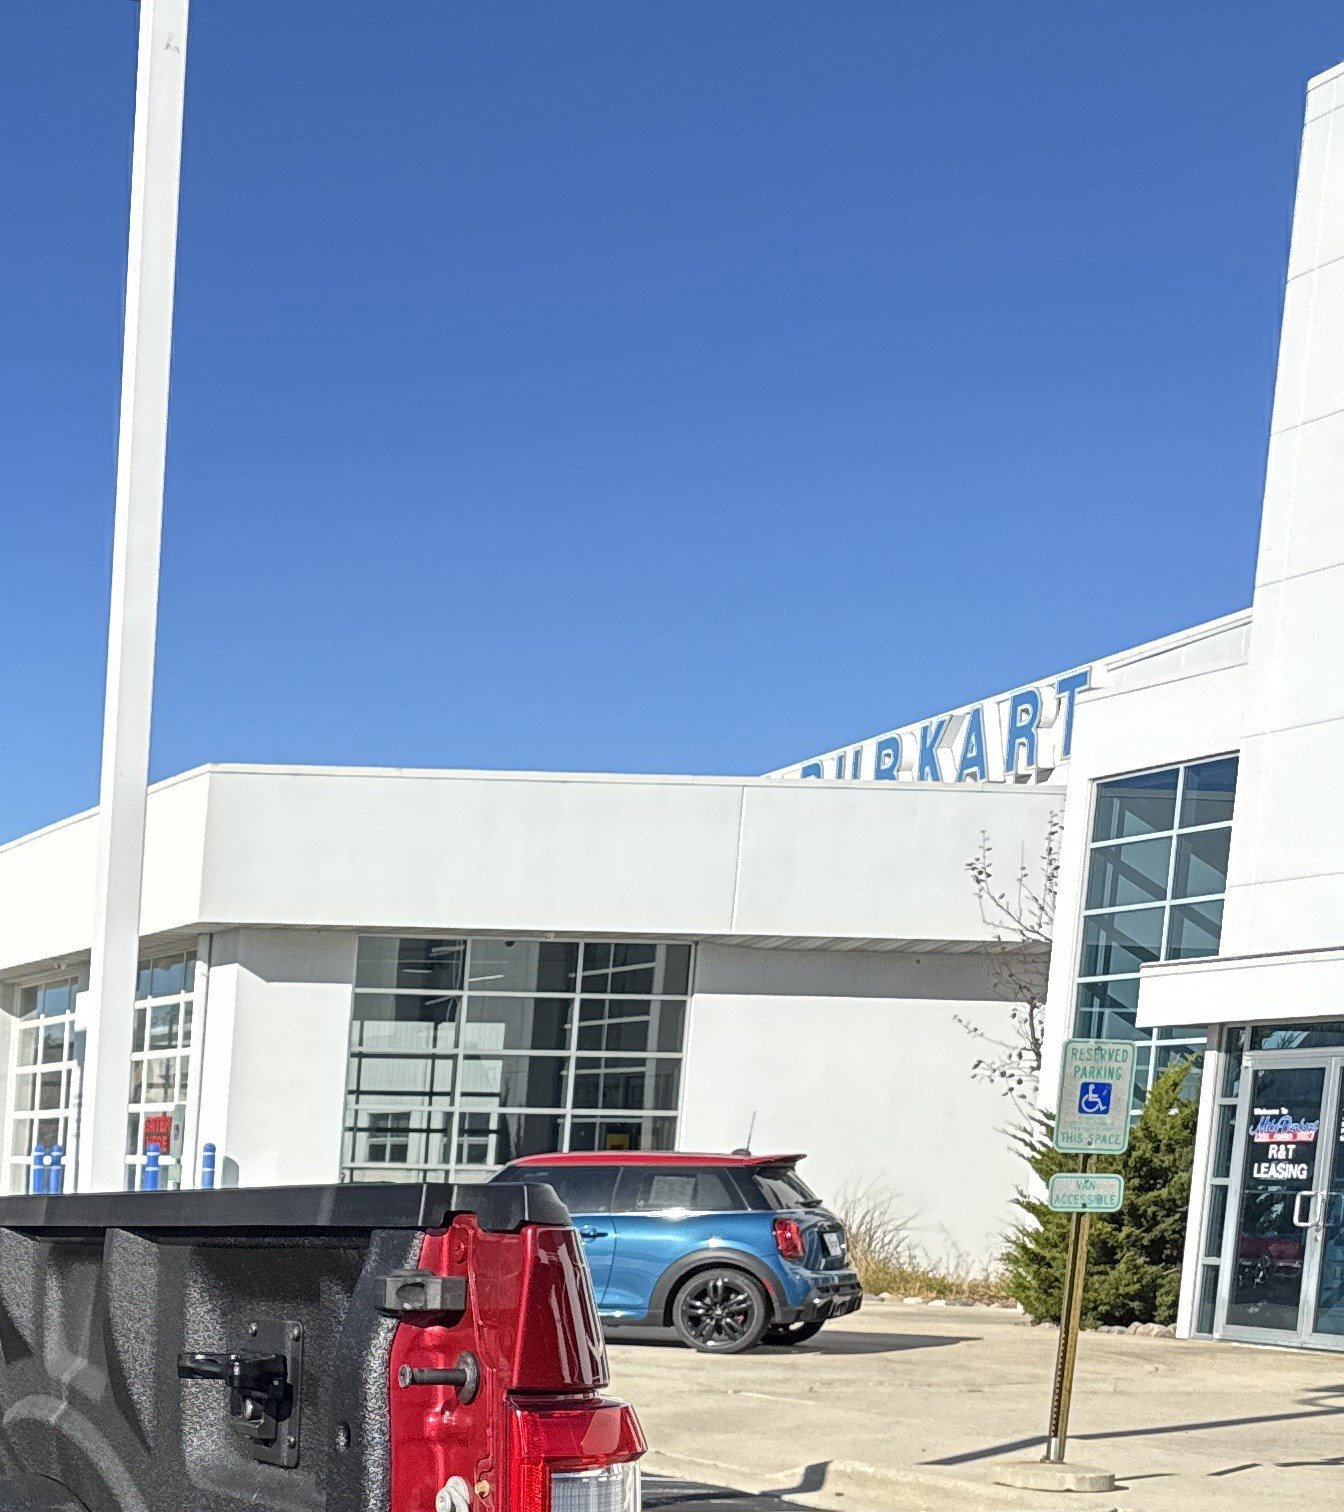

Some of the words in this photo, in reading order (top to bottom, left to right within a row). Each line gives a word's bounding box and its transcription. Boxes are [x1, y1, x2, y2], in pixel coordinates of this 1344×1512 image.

[1070, 1047, 1129, 1063] RESERVED
[1073, 1065, 1123, 1081] PARKING
[1061, 1131, 1083, 1144] THIS
[1088, 1132, 1122, 1146] SPACE
[1268, 1144, 1296, 1159] R&T
[1253, 1162, 1308, 1179] LEASING
[1076, 1179, 1096, 1191] VAN
[1054, 1193, 1117, 1206] ACCESSIBLE
